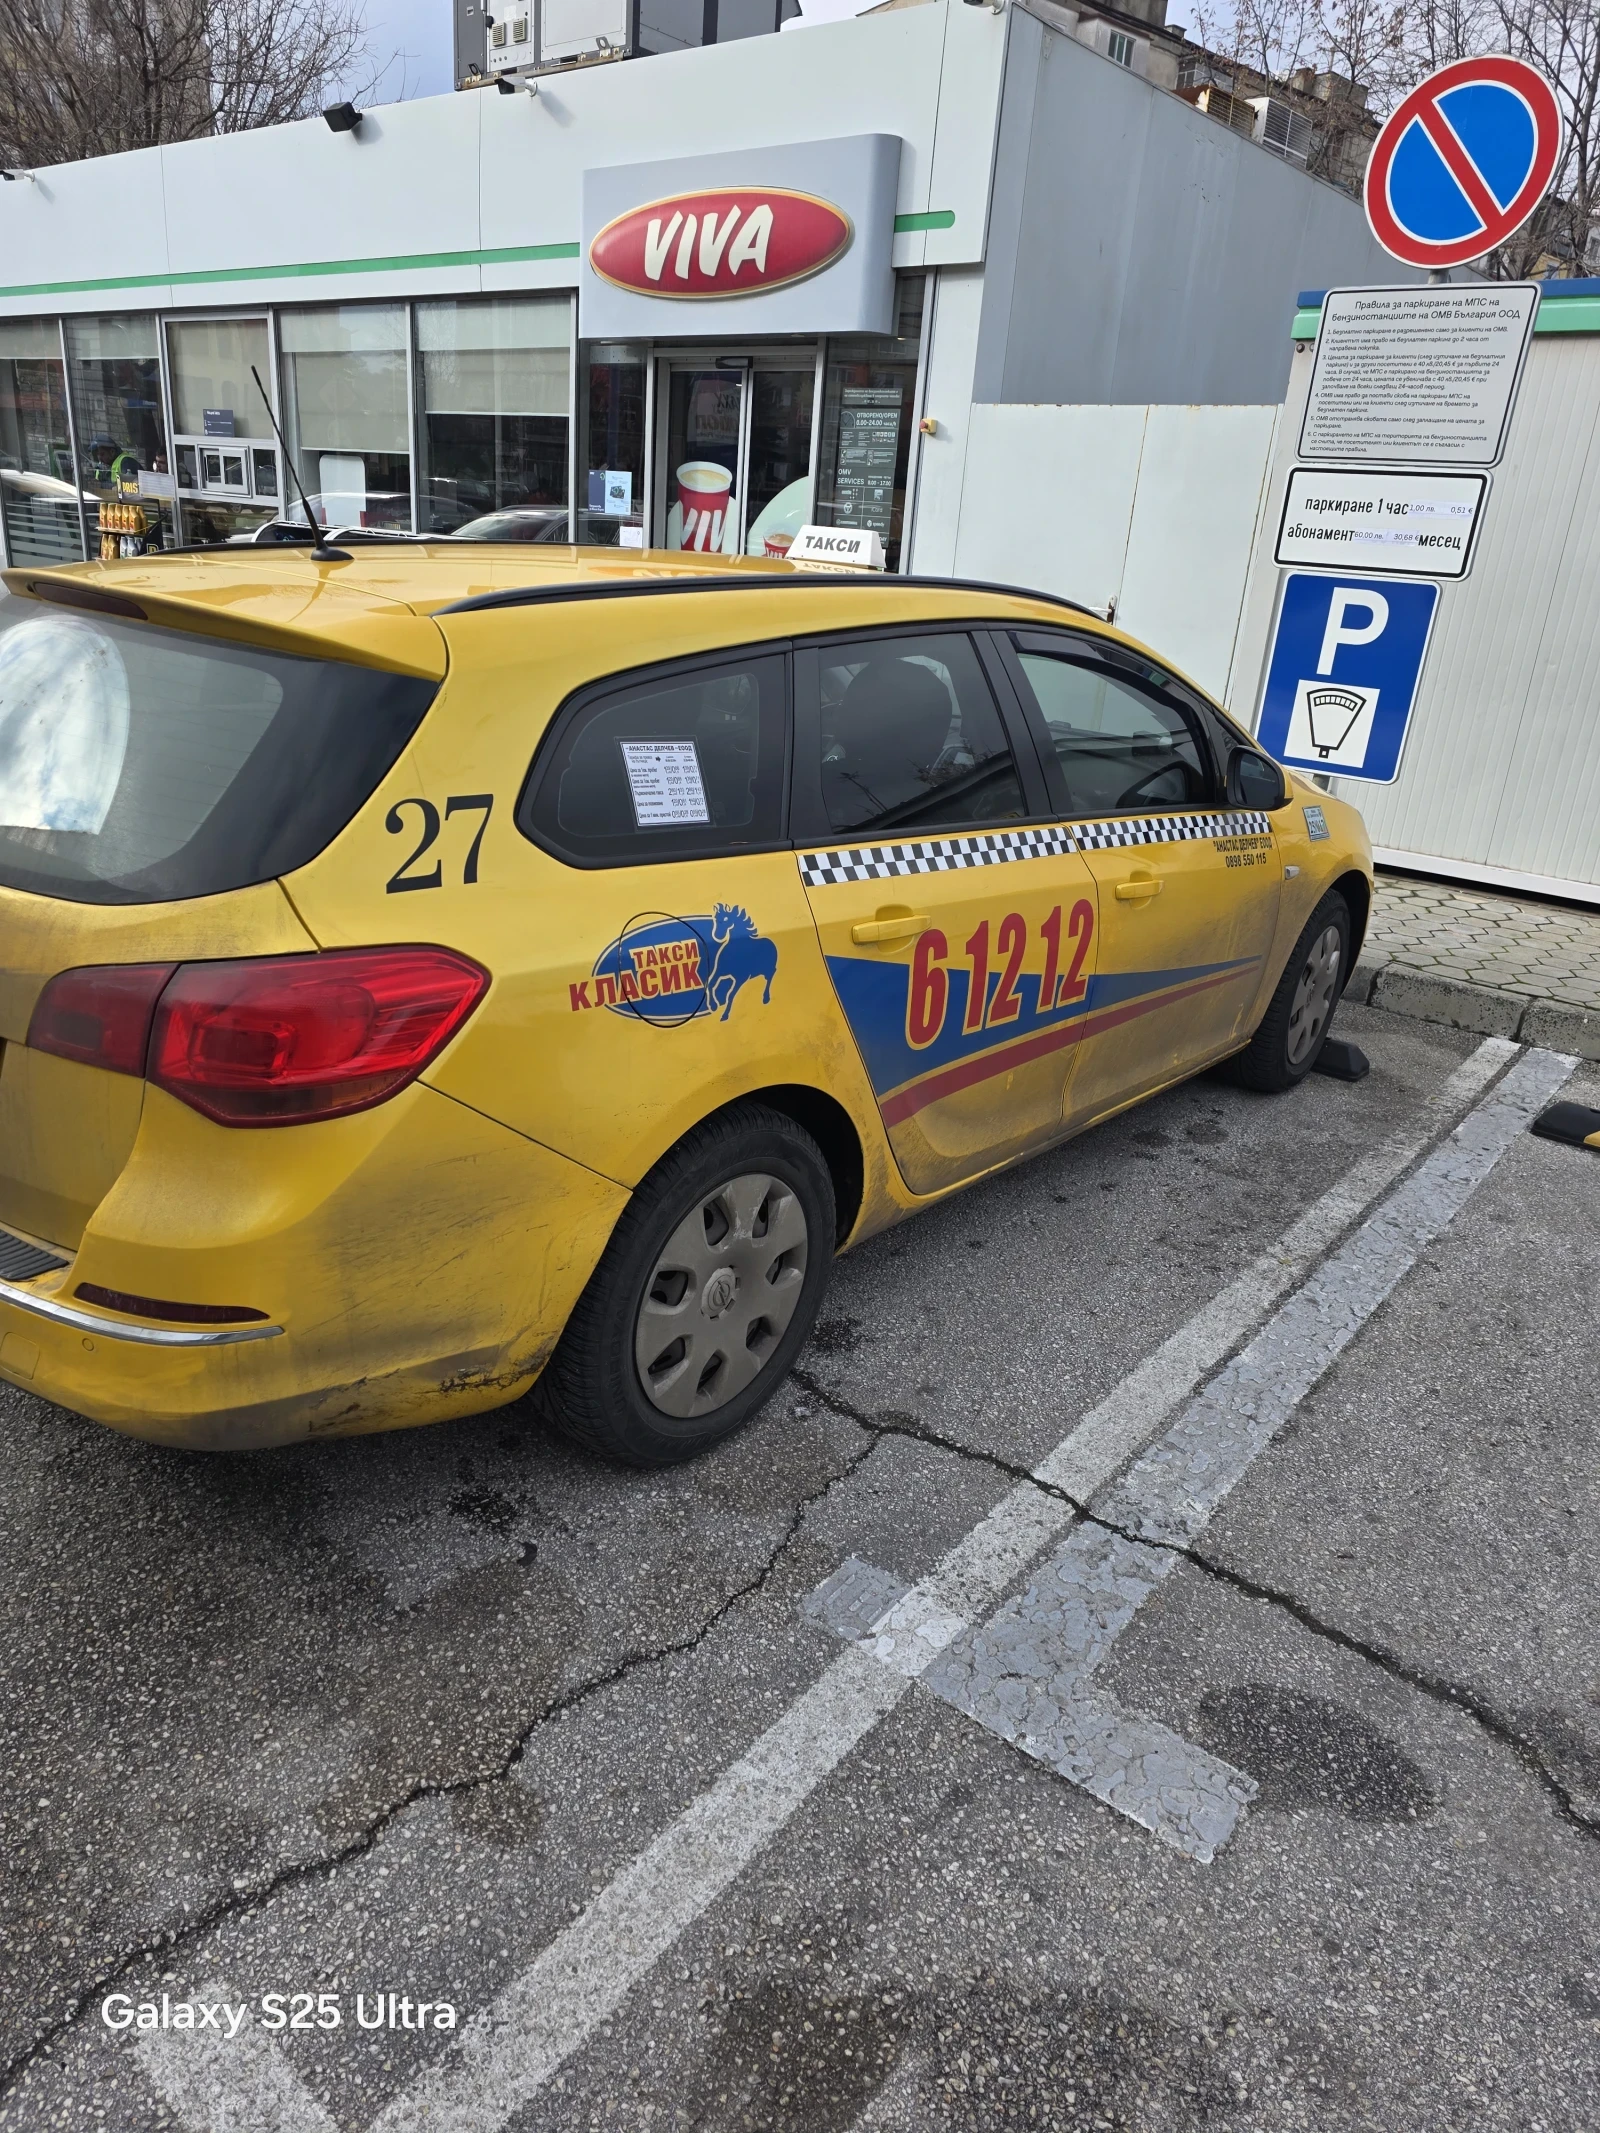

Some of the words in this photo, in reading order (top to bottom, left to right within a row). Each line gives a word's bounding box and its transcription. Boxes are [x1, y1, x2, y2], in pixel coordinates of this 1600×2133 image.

[644, 204, 774, 280] VIVA
[1355, 300, 1390, 310] Правила
[1404, 299, 1450, 309] паркиране
[1465, 298, 1487, 306] МПС
[1332, 313, 1416, 322] бензиностанциите
[1454, 310, 1496, 320] България
[1498, 310, 1520, 319] ООД
[1305, 498, 1373, 516] паркиране
[1378, 498, 1384, 514] 1
[1386, 502, 1409, 515] час
[1288, 523, 1355, 541] абонамент
[805, 536, 861, 553] ТАКСИ
[1418, 534, 1461, 550] месец
[1316, 586, 1389, 676] P
[385, 794, 494, 894] 27
[1226, 855, 1242, 868] 0898
[1243, 854, 1254, 866] 550
[1256, 853, 1267, 864] 115
[632, 940, 699, 972] ТАКСИ
[569, 960, 703, 1012] КЛАСИК
